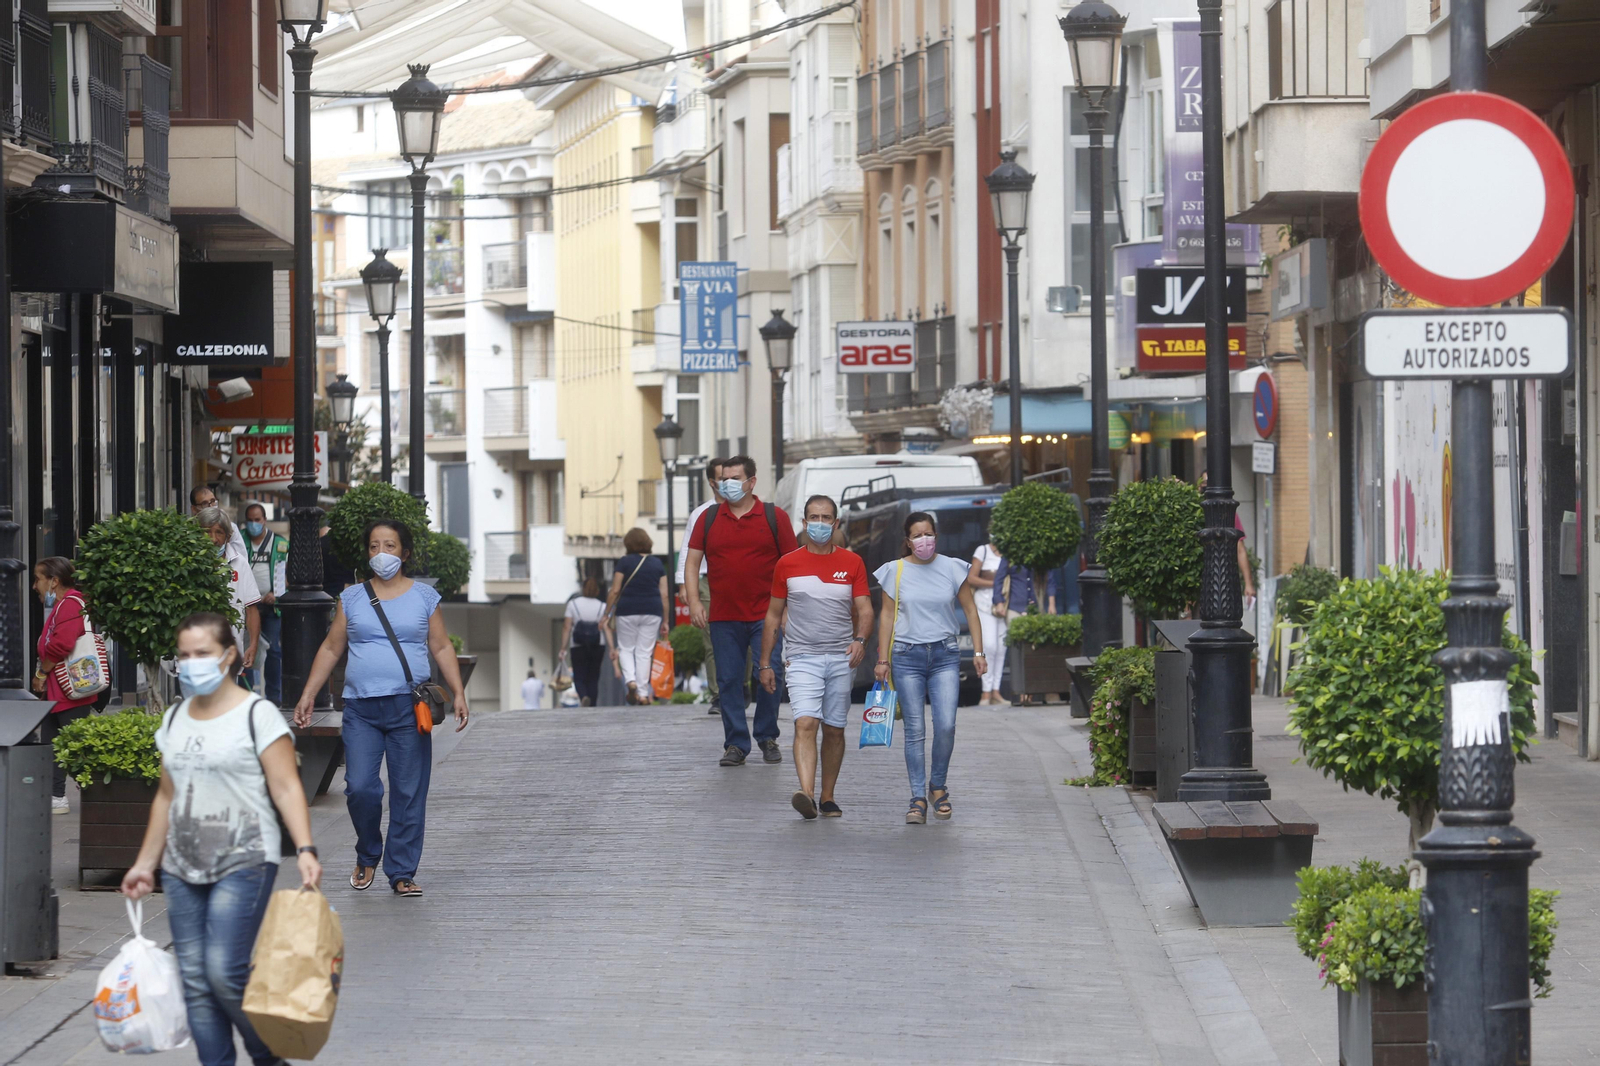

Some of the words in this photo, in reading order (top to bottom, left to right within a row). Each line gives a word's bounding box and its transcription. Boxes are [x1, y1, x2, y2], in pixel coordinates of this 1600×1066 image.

[681, 265, 736, 278] RESTAURANTE
[703, 281, 733, 293] VIA
[839, 329, 912, 338] GESTORIA
[1425, 321, 1507, 342] EXCEPTO
[176, 344, 268, 356] CALZEDONIA
[1164, 339, 1240, 352] TABAS
[682, 351, 737, 370] PIZZERÍA
[840, 344, 913, 366] aras
[1403, 347, 1530, 369] AUTORIZADOS
[236, 435, 321, 455] CONFITEA
